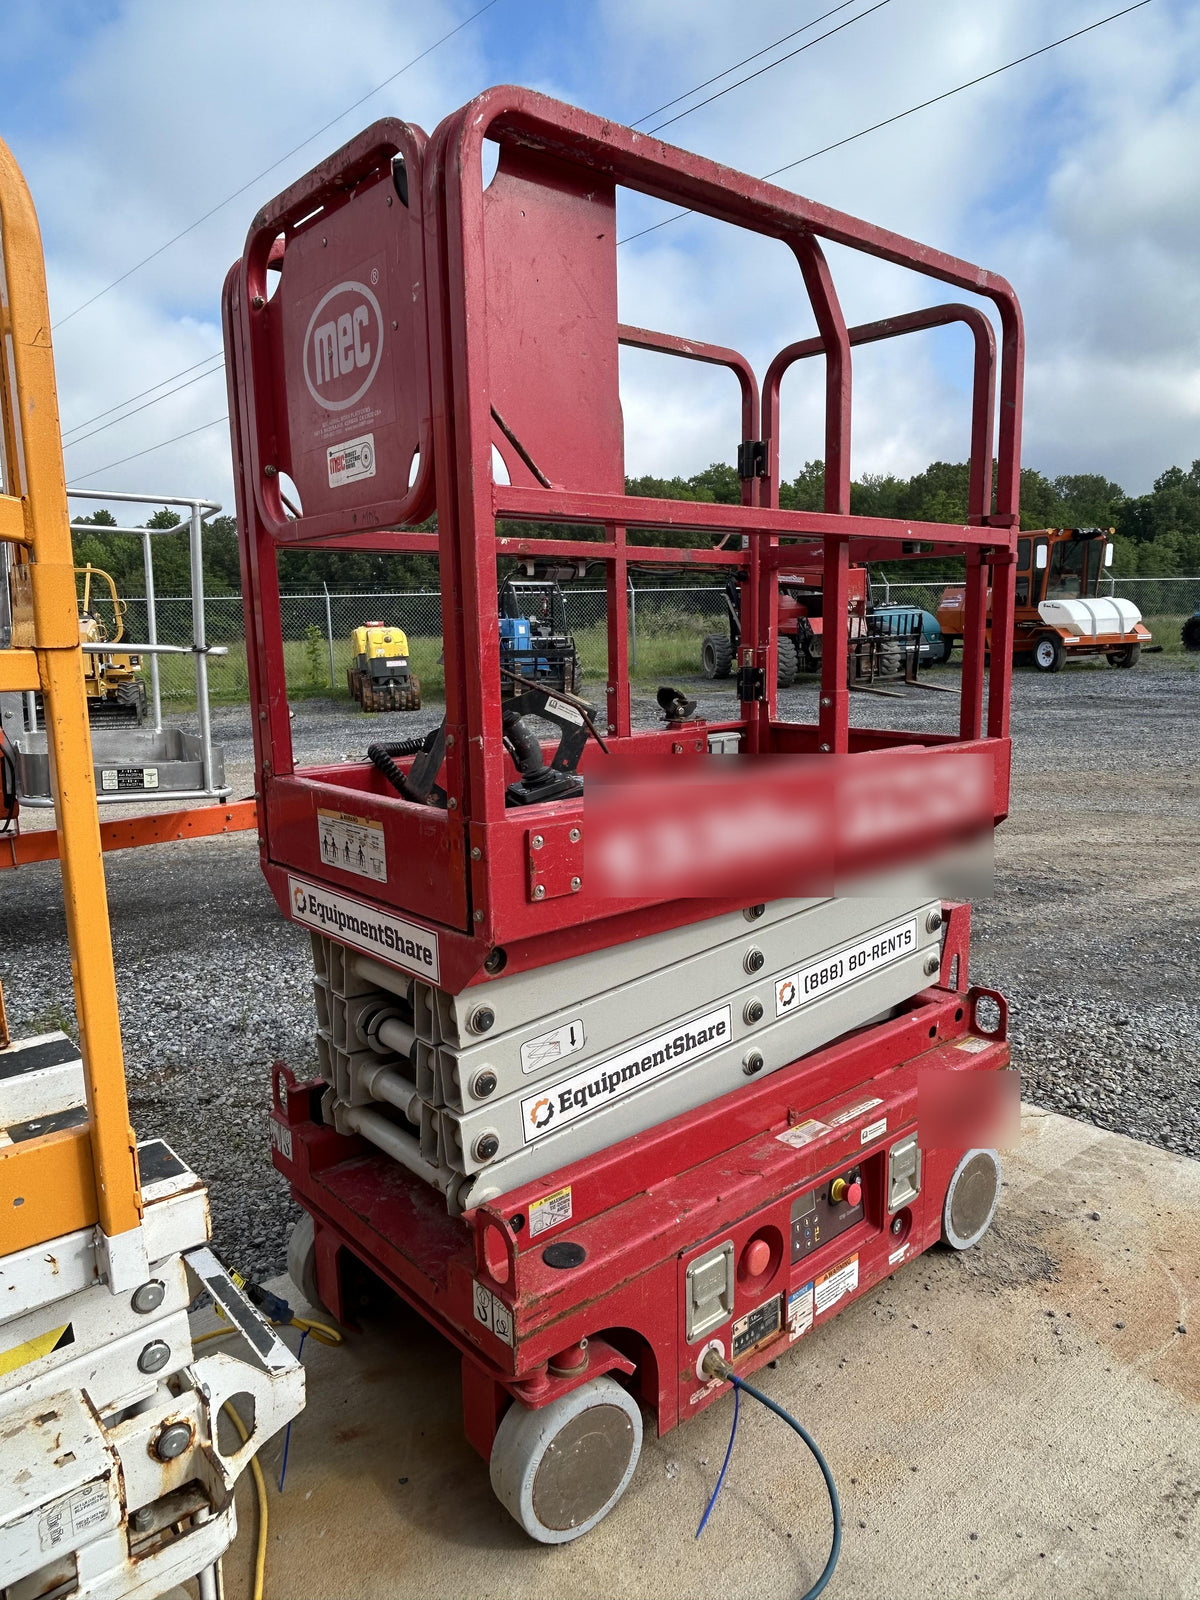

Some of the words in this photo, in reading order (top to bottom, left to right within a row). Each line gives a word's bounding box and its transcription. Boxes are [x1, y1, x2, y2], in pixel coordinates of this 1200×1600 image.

[308, 893, 433, 967] EquipmentShare
[804, 960, 844, 994] (888)
[849, 930, 912, 971] 80-RENTS
[558, 1020, 726, 1114] EquipmentShare
[792, 1285, 809, 1300] NOTICE
[827, 1257, 852, 1277] WARNING
